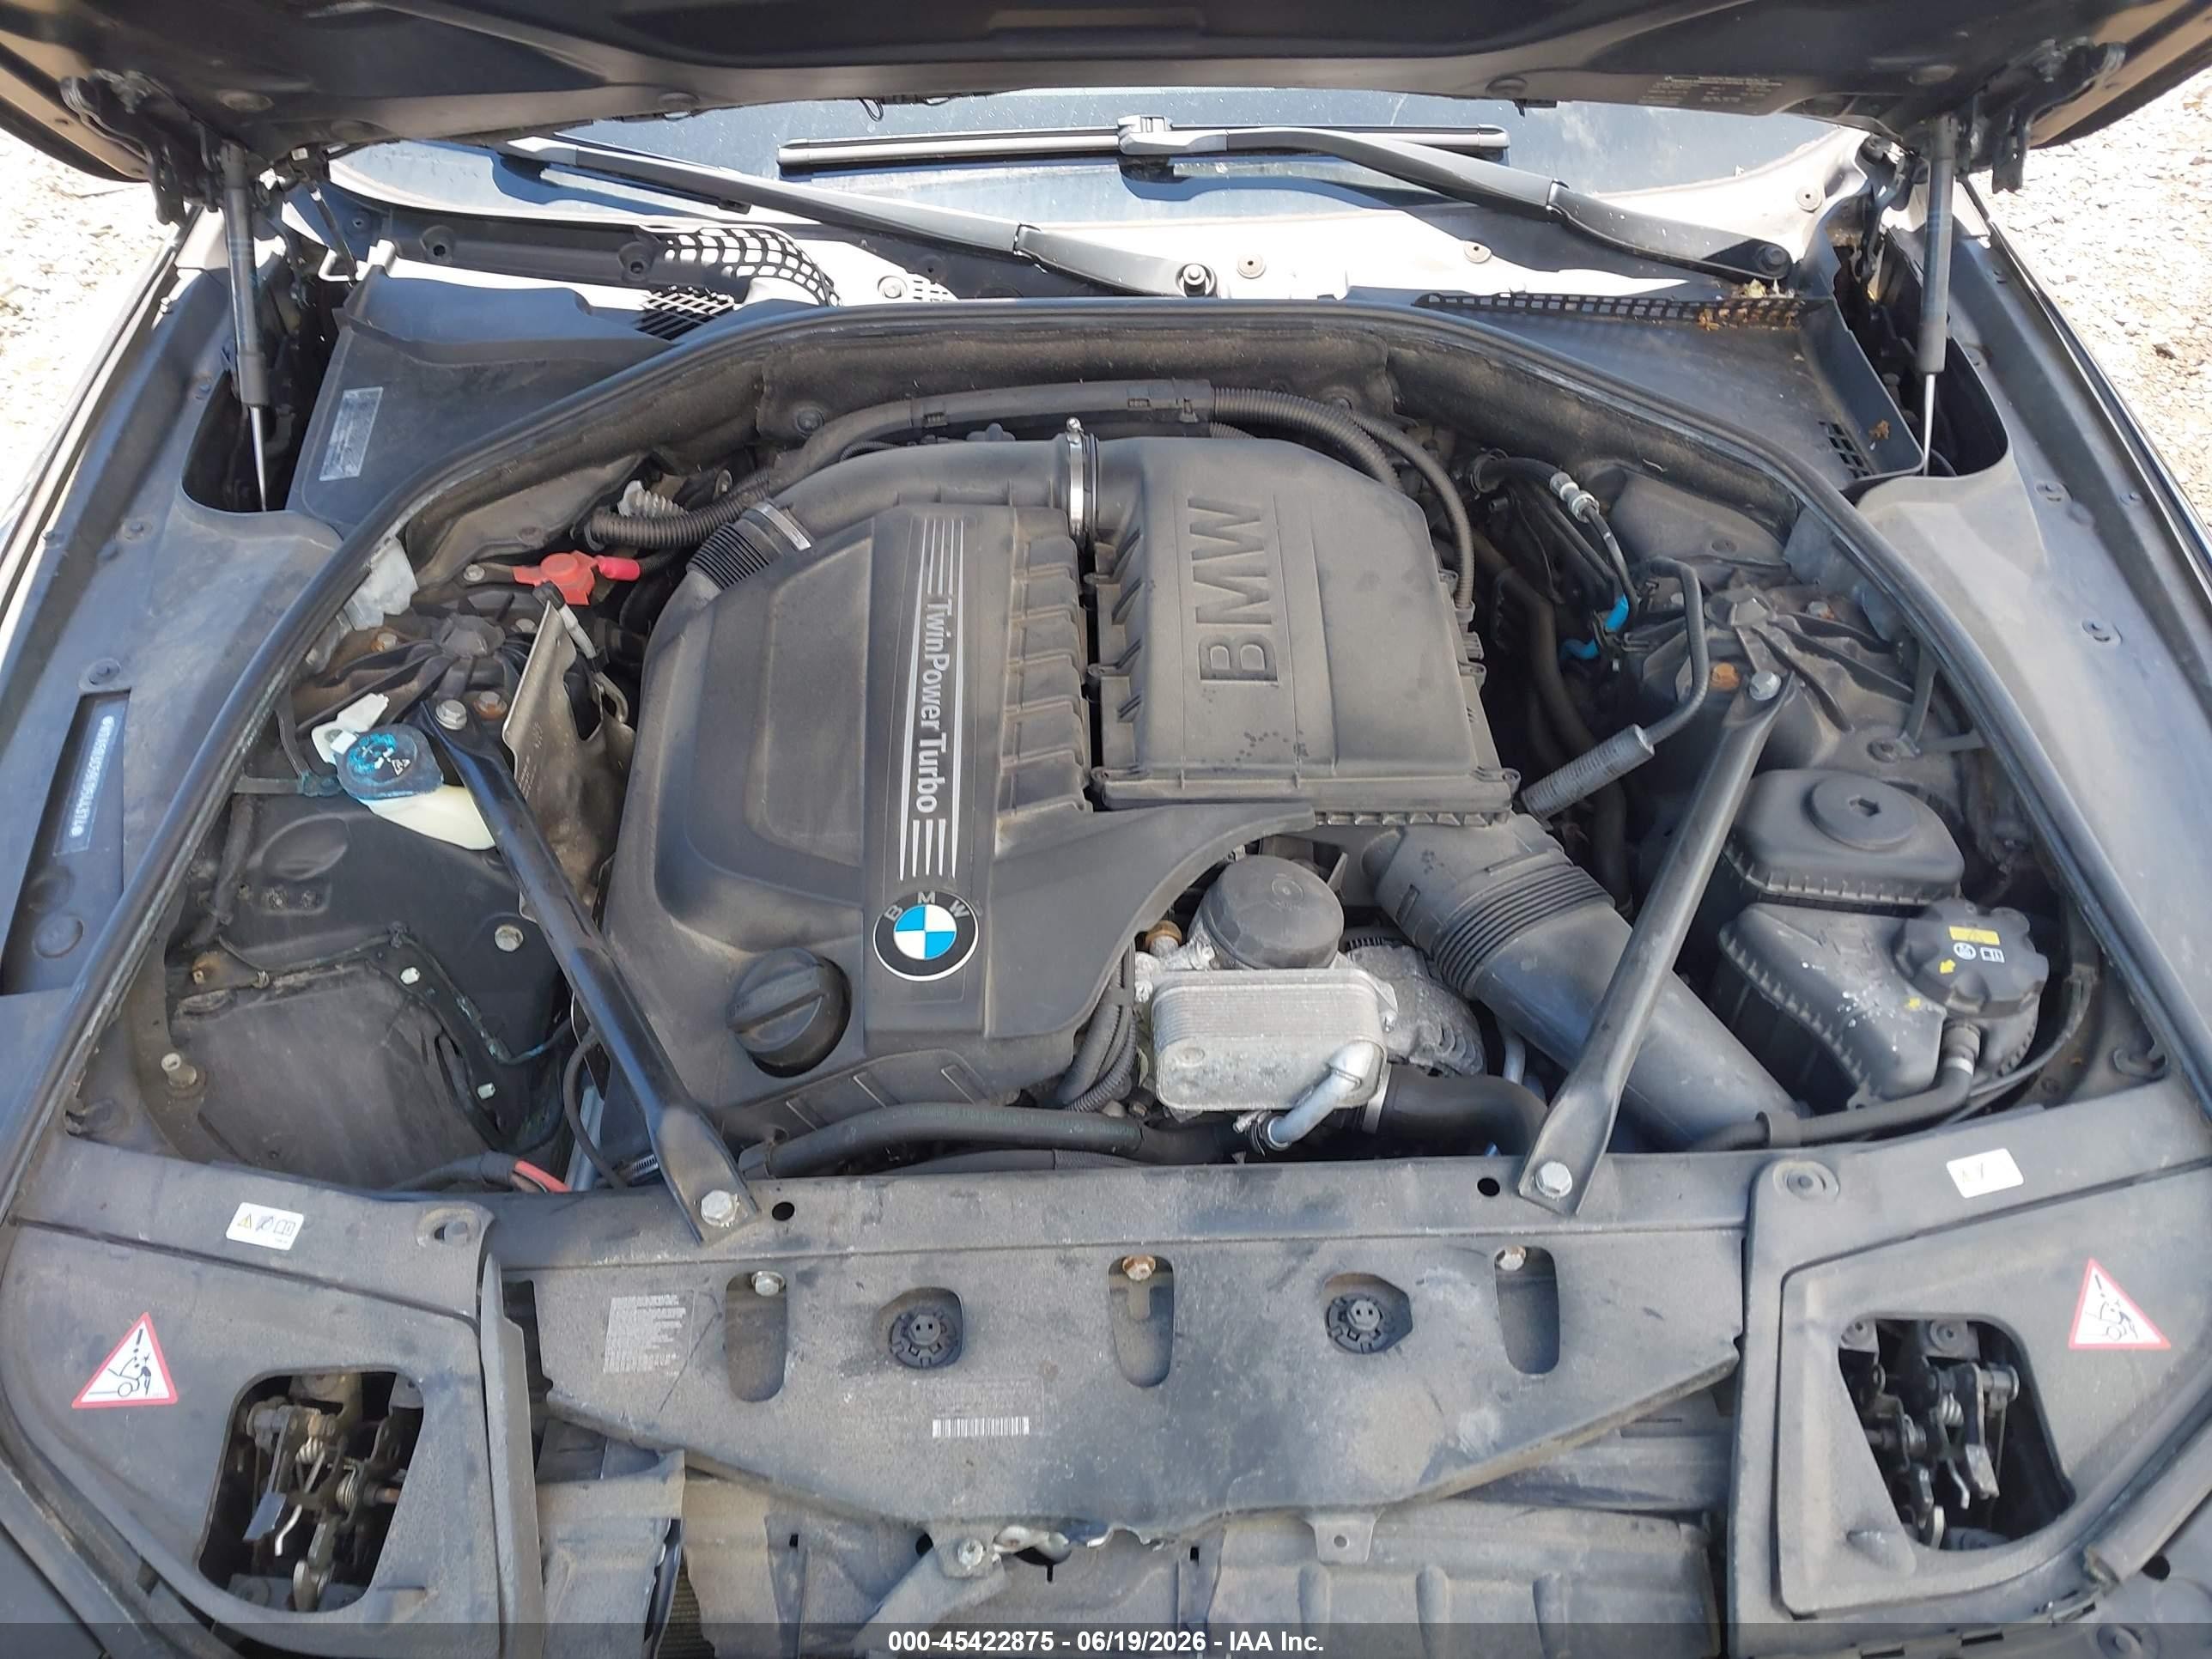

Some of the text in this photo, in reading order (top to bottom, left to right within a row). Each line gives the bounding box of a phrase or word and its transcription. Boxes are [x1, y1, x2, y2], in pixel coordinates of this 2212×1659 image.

[1188, 495, 1279, 684] BMW
[915, 599, 952, 813] TwinPower Turbo
[884, 891, 969, 921] BMW
